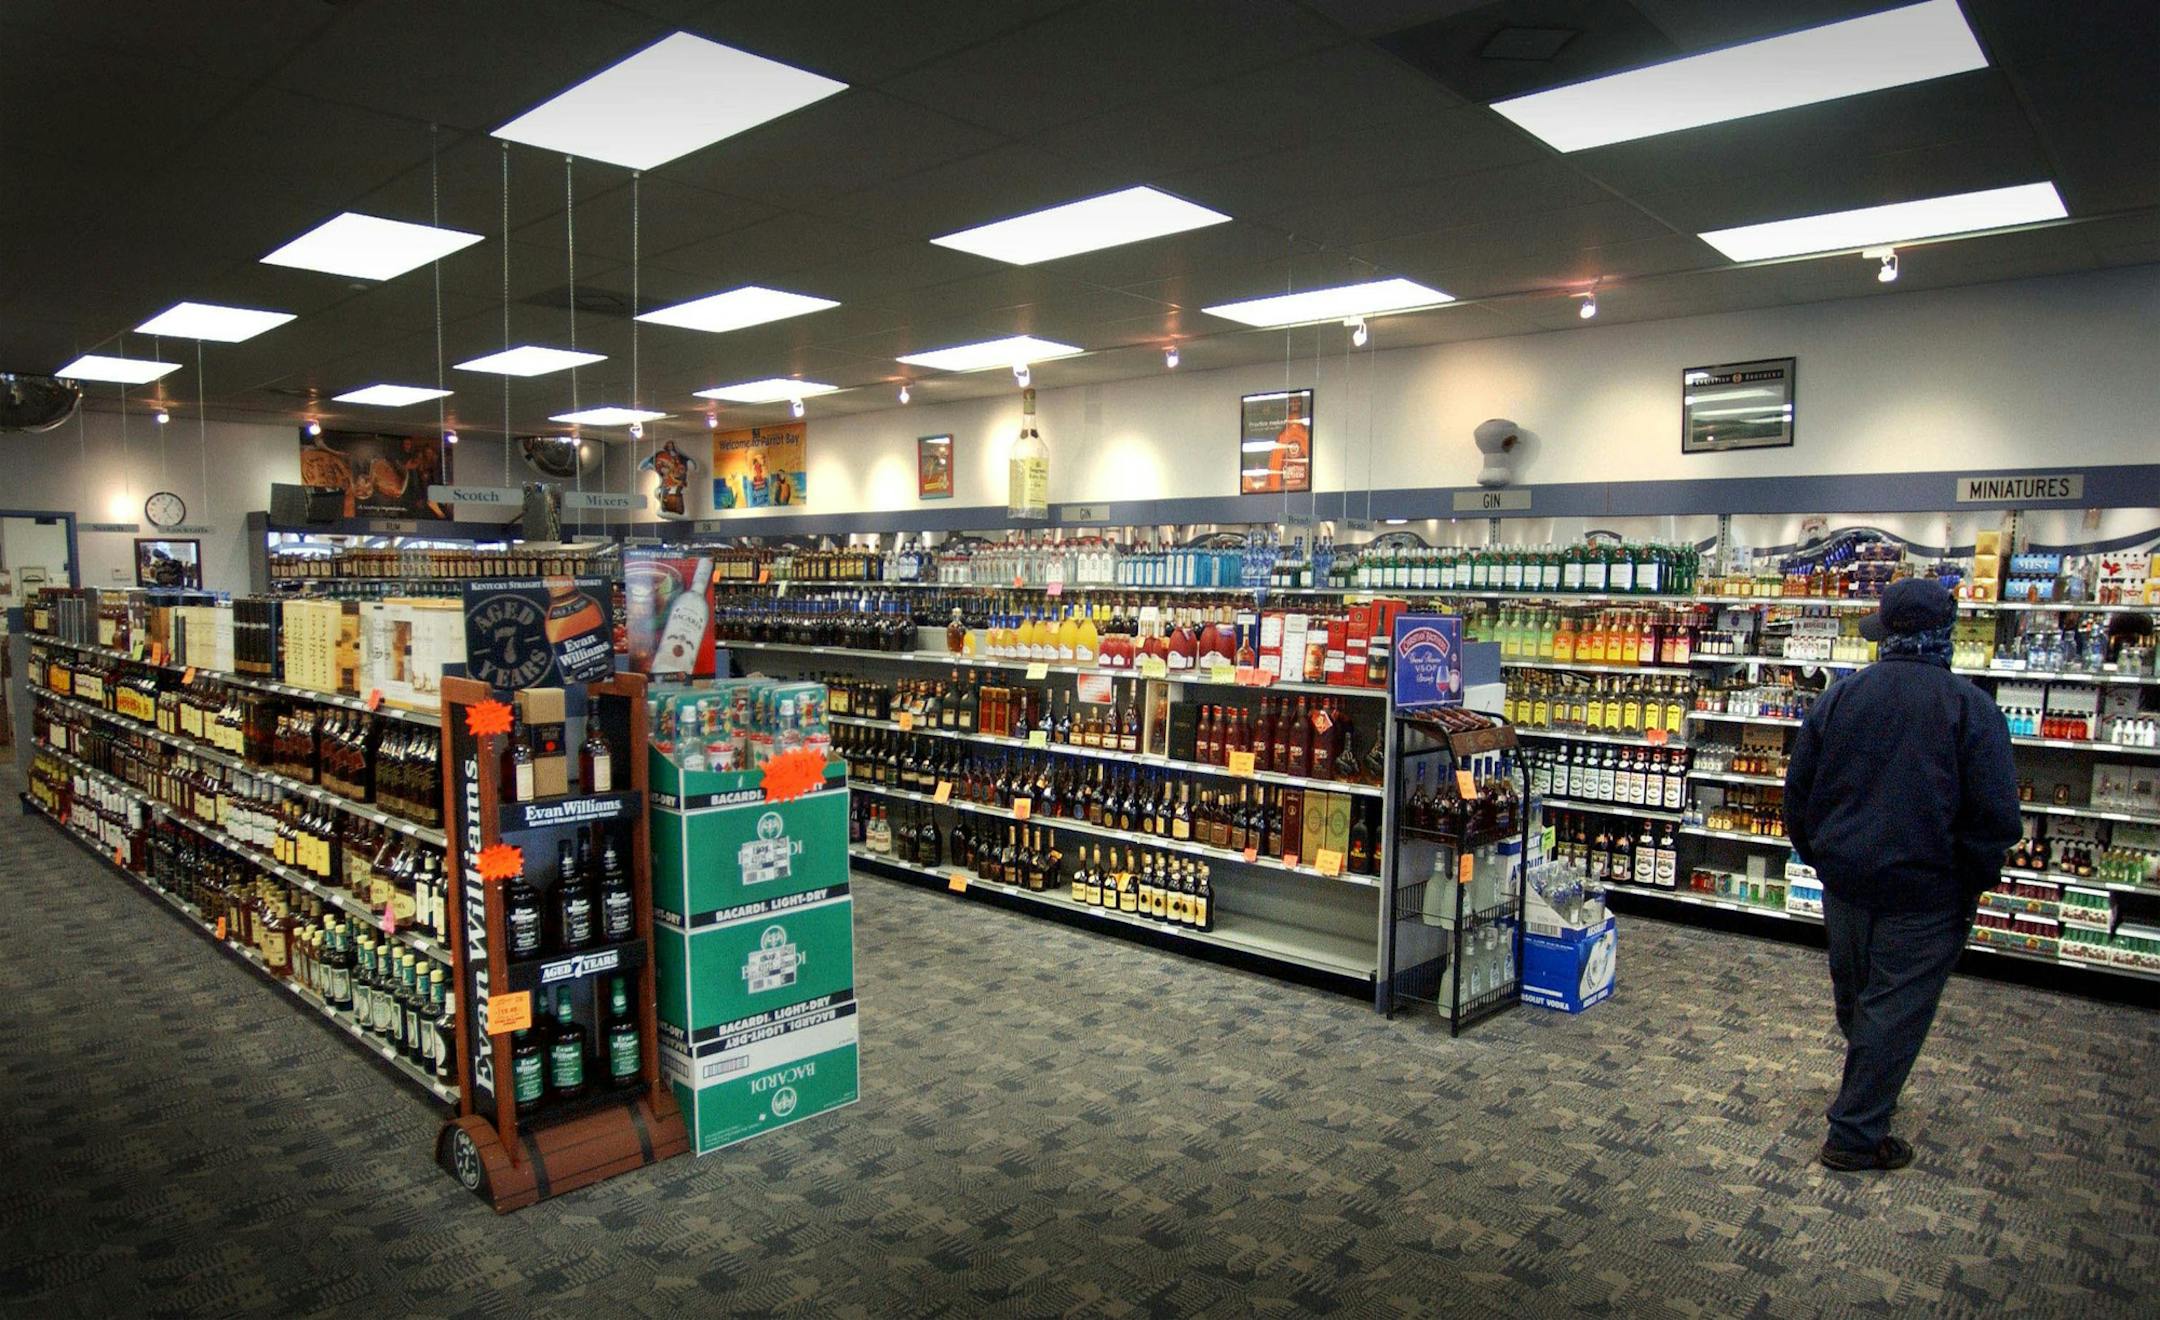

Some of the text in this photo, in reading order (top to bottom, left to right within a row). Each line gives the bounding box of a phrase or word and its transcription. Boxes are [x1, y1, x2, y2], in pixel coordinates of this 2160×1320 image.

[719, 439, 750, 450] Welcome
[784, 432, 800, 447] Bay
[453, 489, 499, 502] Scotch
[586, 494, 629, 507] Mixers
[1483, 494, 1501, 508] GIN
[1969, 478, 2070, 499] MINIATURES
[1079, 507, 1092, 520] GIN
[474, 601, 536, 635] AGED
[494, 625, 518, 665] 7
[560, 641, 610, 666] Williams
[564, 634, 596, 653] Evan
[478, 648, 548, 688] YEARS
[711, 789, 764, 806] BACARDI
[464, 758, 487, 963] Williams
[716, 888, 828, 922] BACARDI LIGHT-DRY
[543, 953, 619, 980] AGED 7 YEARS
[719, 996, 831, 1036] BACARDI LIGHT-DRY
[1546, 998, 1570, 1011] VODKA
[475, 970, 494, 1098] Evan
[724, 1010, 836, 1050] BACARDI LIGHT-DRY
[751, 1062, 816, 1095] BACARDI
